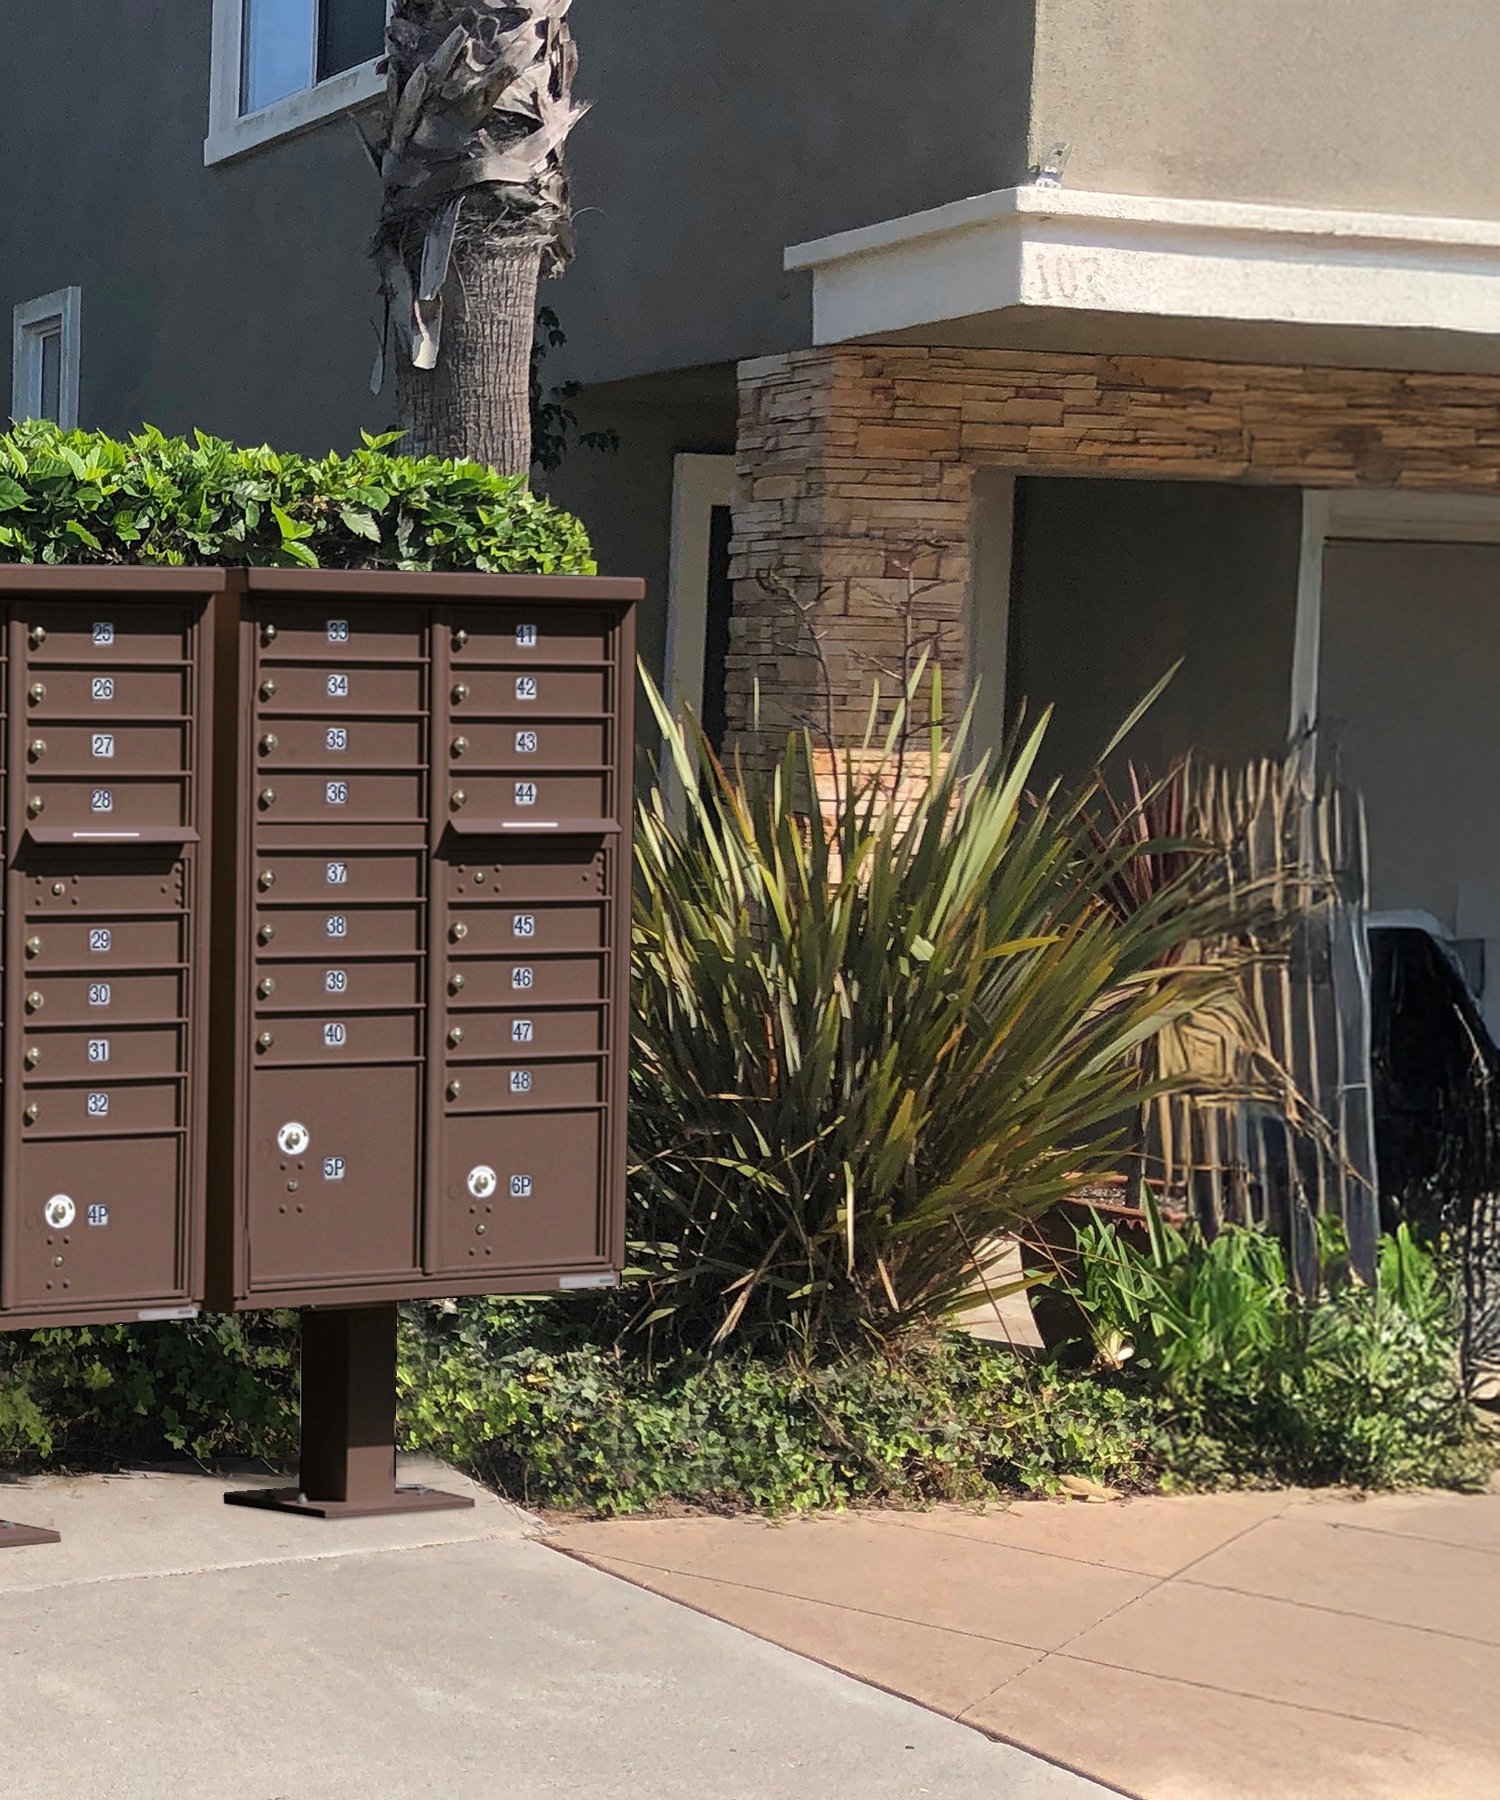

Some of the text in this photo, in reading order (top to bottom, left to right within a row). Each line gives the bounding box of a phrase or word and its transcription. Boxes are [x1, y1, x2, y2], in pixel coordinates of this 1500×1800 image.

[93, 624, 111, 642] 25
[329, 623, 347, 640] 33
[516, 626, 533, 643] 41
[94, 680, 112, 698] 26
[328, 677, 346, 694] 34
[517, 678, 535, 695] 42
[95, 736, 112, 754] 27
[327, 730, 345, 748] 35
[517, 733, 535, 750] 43
[93, 791, 110, 809] 28
[328, 785, 346, 802] 36
[516, 784, 534, 801] 44
[328, 865, 346, 882] 37
[327, 917, 345, 934] 38
[515, 917, 533, 934] 45
[91, 931, 110, 949] 29
[327, 972, 345, 990] 39
[513, 970, 531, 987] 46
[89, 985, 109, 1003] 30
[325, 1024, 343, 1042] 40
[513, 1023, 531, 1040] 47
[89, 1042, 107, 1060] 31
[511, 1072, 530, 1089] 48
[88, 1095, 107, 1112] 32
[325, 1158, 344, 1176] 5P
[511, 1176, 530, 1194] 6P
[88, 1205, 109, 1223] 4P
